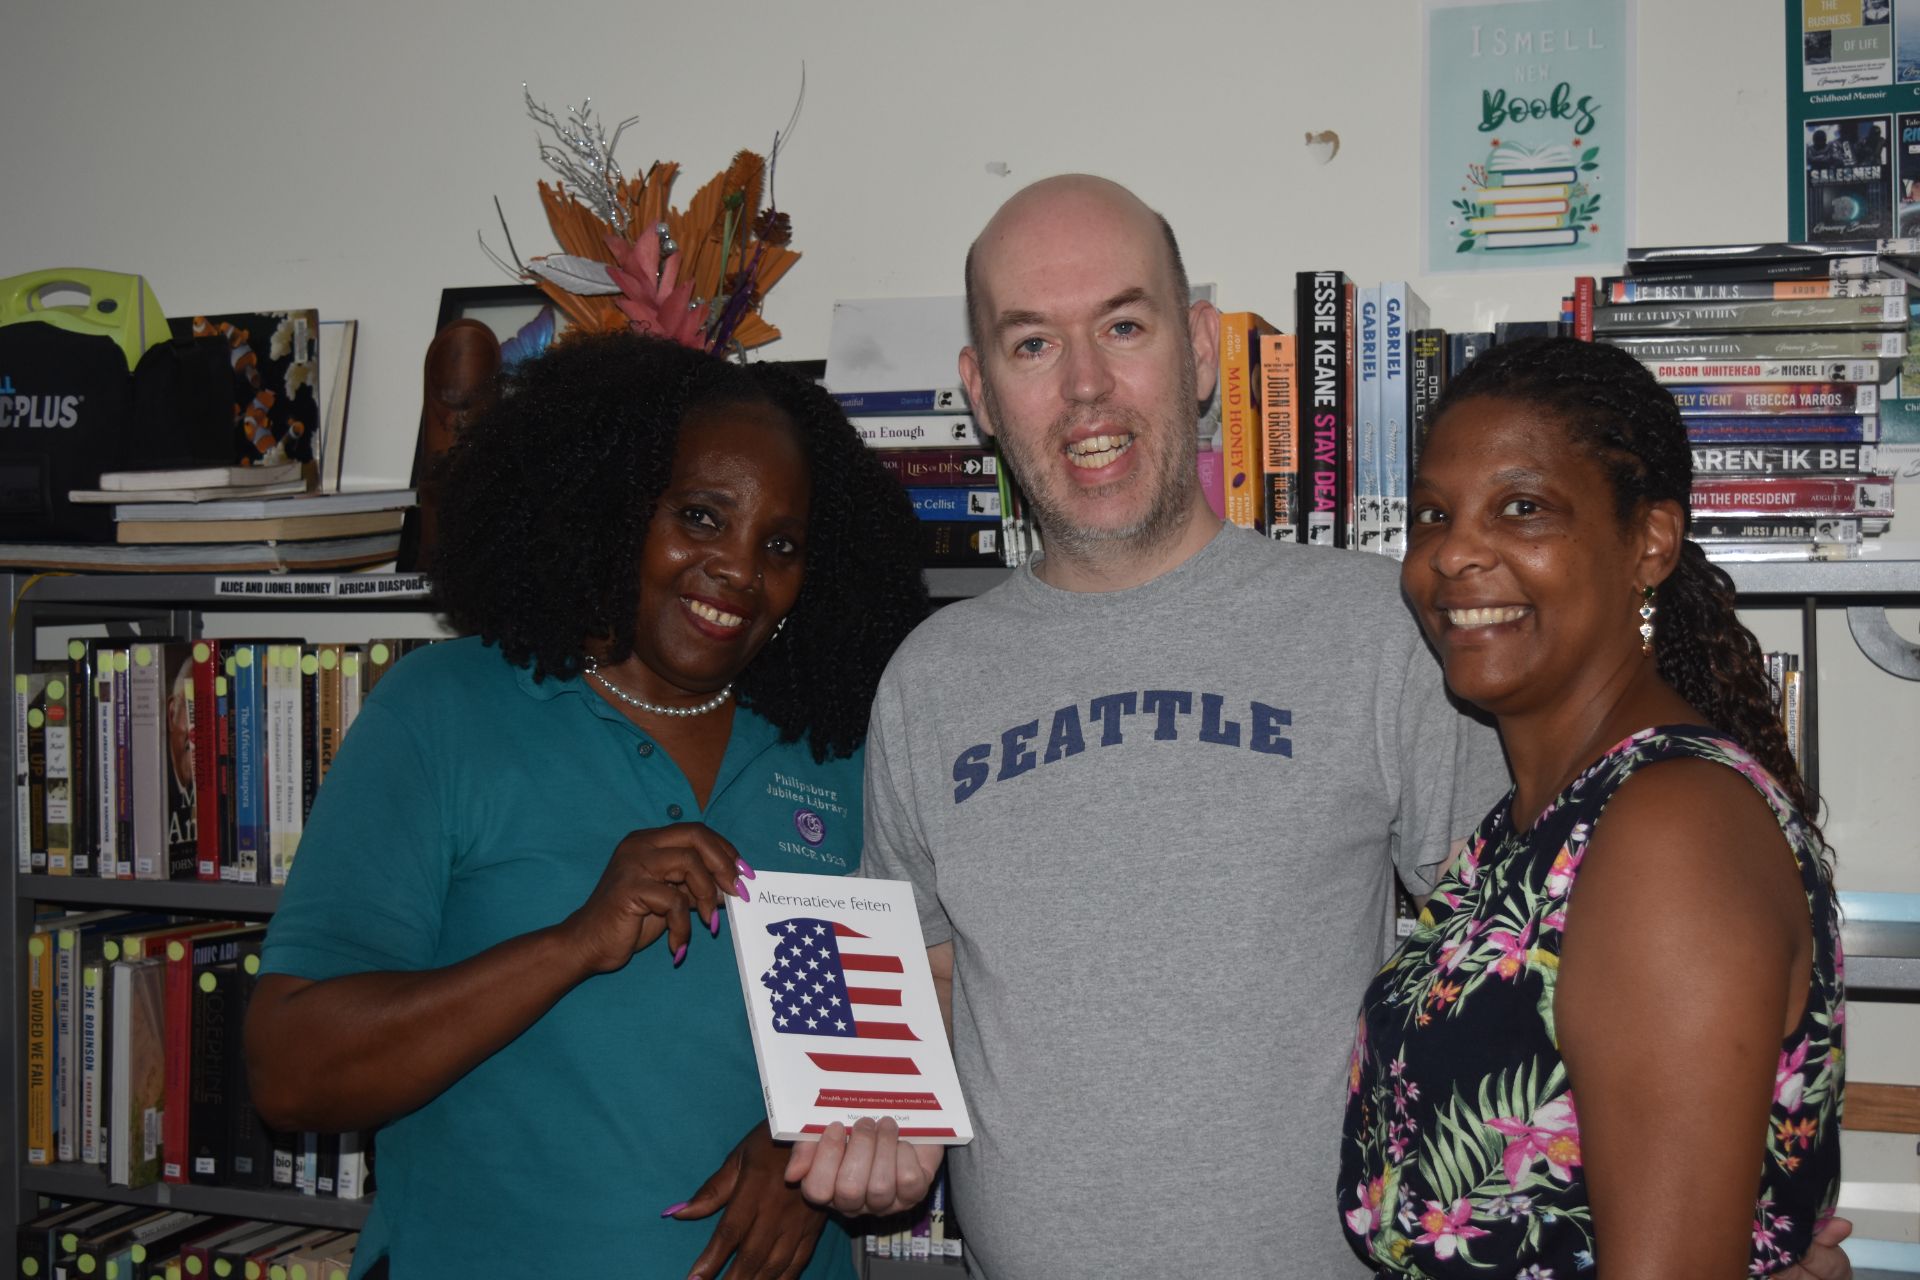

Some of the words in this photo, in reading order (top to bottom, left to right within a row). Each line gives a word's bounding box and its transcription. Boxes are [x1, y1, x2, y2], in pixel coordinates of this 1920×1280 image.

[1821, 0, 1839, 10] THE
[1807, 14, 1852, 27] BUSINESS
[1493, 27, 1604, 56] SMELL
[1843, 40, 1855, 51] OF
[1859, 38, 1879, 50] LIFE
[1515, 63, 1550, 83] NEW
[1809, 93, 1852, 104] Childhood
[1853, 90, 1887, 100] Memoir
[1478, 82, 1602, 135] Books
[1810, 166, 1882, 183] SALESMEN
[1634, 287, 1648, 298] HE
[1655, 285, 1687, 298] BEST
[1613, 312, 1635, 322] THE
[1637, 310, 1692, 322] CATALYST
[1694, 308, 1738, 320] WITHIN
[1225, 325, 1233, 361] PICOULT
[1362, 302, 1377, 381] GABRIEL
[1386, 297, 1401, 380] GABRIEL
[1620, 346, 1640, 356] HE
[1642, 345, 1696, 356] CATALYST
[1699, 344, 1741, 354] WITHIN
[1314, 340, 1335, 407] KEANE
[1659, 366, 1698, 377] COLSON
[1702, 366, 1760, 377] WHITEHEAD
[1781, 365, 1819, 377] NICKEL
[1226, 367, 1241, 405] MAD
[1266, 375, 1290, 408] JOHN
[1416, 359, 1426, 421] BENTLEY
[1428, 375, 1438, 405] DON
[1699, 394, 1733, 406] EVENT
[1745, 394, 1796, 406] REBECCA
[1799, 393, 1842, 406] YARROS
[859, 429, 876, 439] an
[880, 425, 925, 441] Enough
[1228, 410, 1243, 469] HONEY
[1266, 411, 1291, 467] GRISHAM
[1313, 413, 1335, 466] STAY
[882, 460, 899, 469] ROL
[907, 461, 928, 477] LIES
[1783, 449, 1811, 470] IK
[1273, 477, 1288, 490] THE
[1314, 471, 1335, 513] DEA
[924, 499, 955, 510] Cellist
[1689, 493, 1707, 505] ITH
[1709, 493, 1731, 505] THE
[1734, 492, 1796, 505] PRESIDENT
[1810, 493, 1842, 501] AUGUST
[1741, 526, 1770, 537] JUSSI
[221, 581, 244, 593] ALICE
[245, 582, 263, 594] AND
[264, 582, 292, 594] LIONEL
[294, 582, 331, 594] ROMNEY
[339, 582, 376, 595] AFRICAN
[378, 579, 424, 593] DIASPORA
[17, 692, 25, 734] eplenishing
[239, 706, 249, 727] The
[30, 731, 44, 747] IL
[239, 727, 250, 763] African
[321, 727, 332, 766] BLACK
[953, 690, 1293, 804] SEATTLE
[30, 754, 44, 777] UP
[239, 764, 250, 808] Diaspora
[774, 772, 837, 801] Philipsburg
[766, 784, 805, 802] Jubilee
[807, 795, 848, 818] Library
[778, 841, 818, 860] SINCE
[171, 858, 194, 875] JOHN
[758, 890, 846, 910] Alternatieve
[850, 896, 892, 912] feiten
[59, 955, 68, 969] SKY
[59, 971, 68, 980] IS
[59, 983, 68, 997] NOT
[59, 1000, 68, 1013] THE
[59, 1014, 68, 1035] LIMIT
[30, 1042, 43, 1061] WE
[84, 1014, 94, 1072] ROBINSON
[205, 989, 223, 1105] JOSEPHINE
[31, 1064, 43, 1089] FAIL
[276, 1155, 291, 1168] bio
